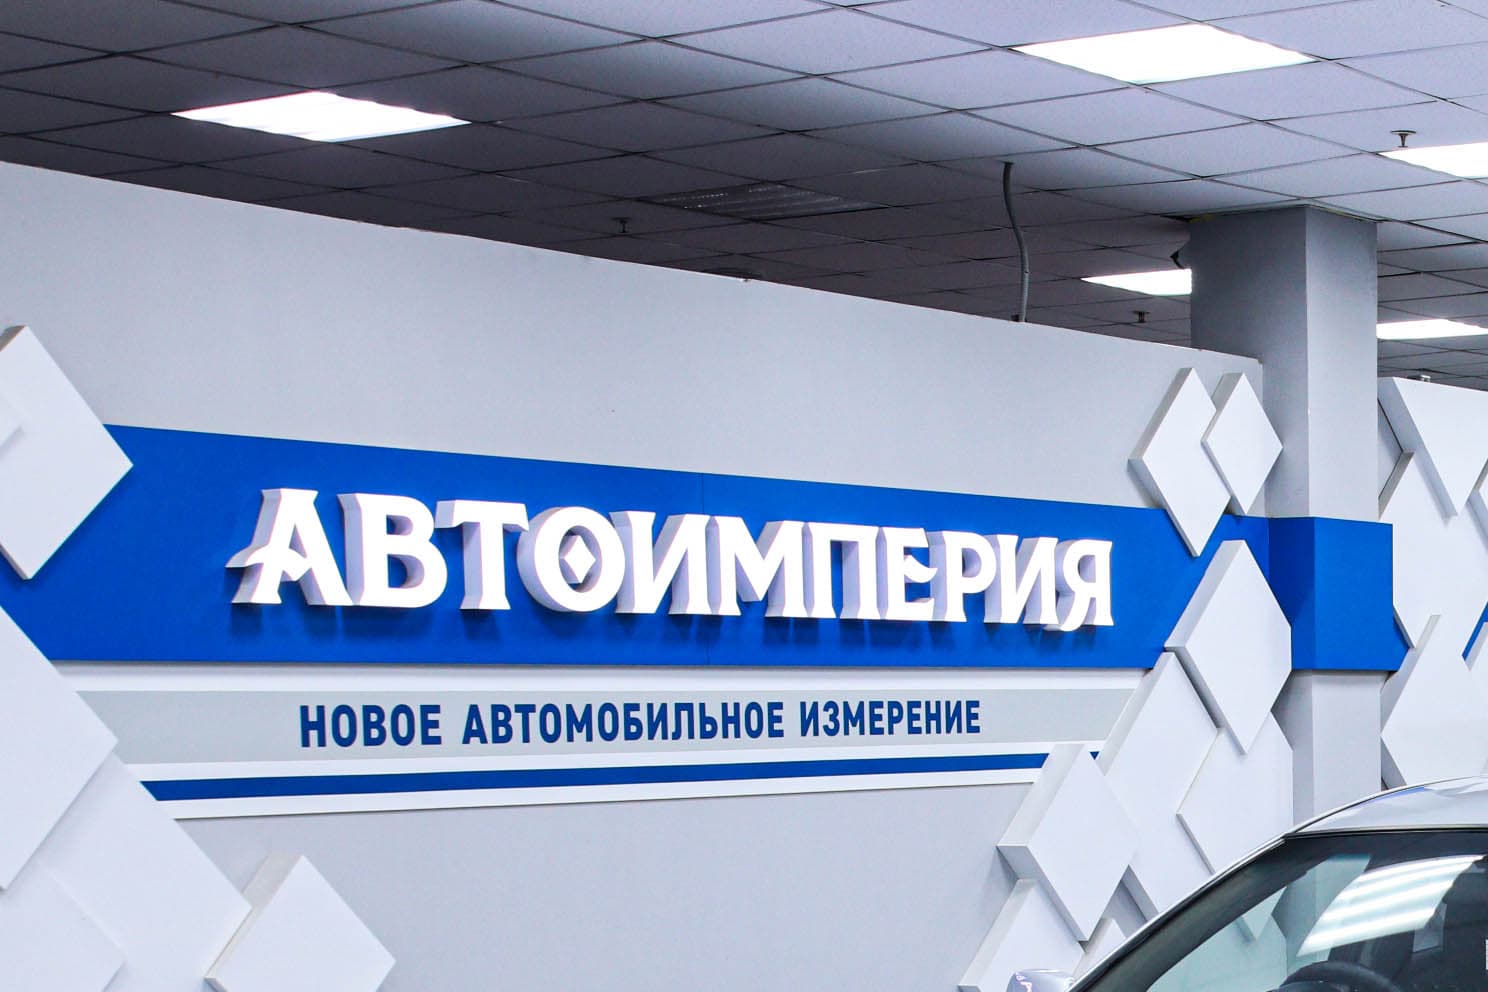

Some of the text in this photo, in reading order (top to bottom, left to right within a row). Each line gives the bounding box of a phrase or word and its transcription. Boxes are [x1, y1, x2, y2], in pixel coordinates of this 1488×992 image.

[225, 488, 1114, 631] АВТОИМПЕРИЯ
[299, 697, 981, 747] НОВОЕ АВТОМОБИЛЬНОЕ ИЗМЕРЕНИЕ
